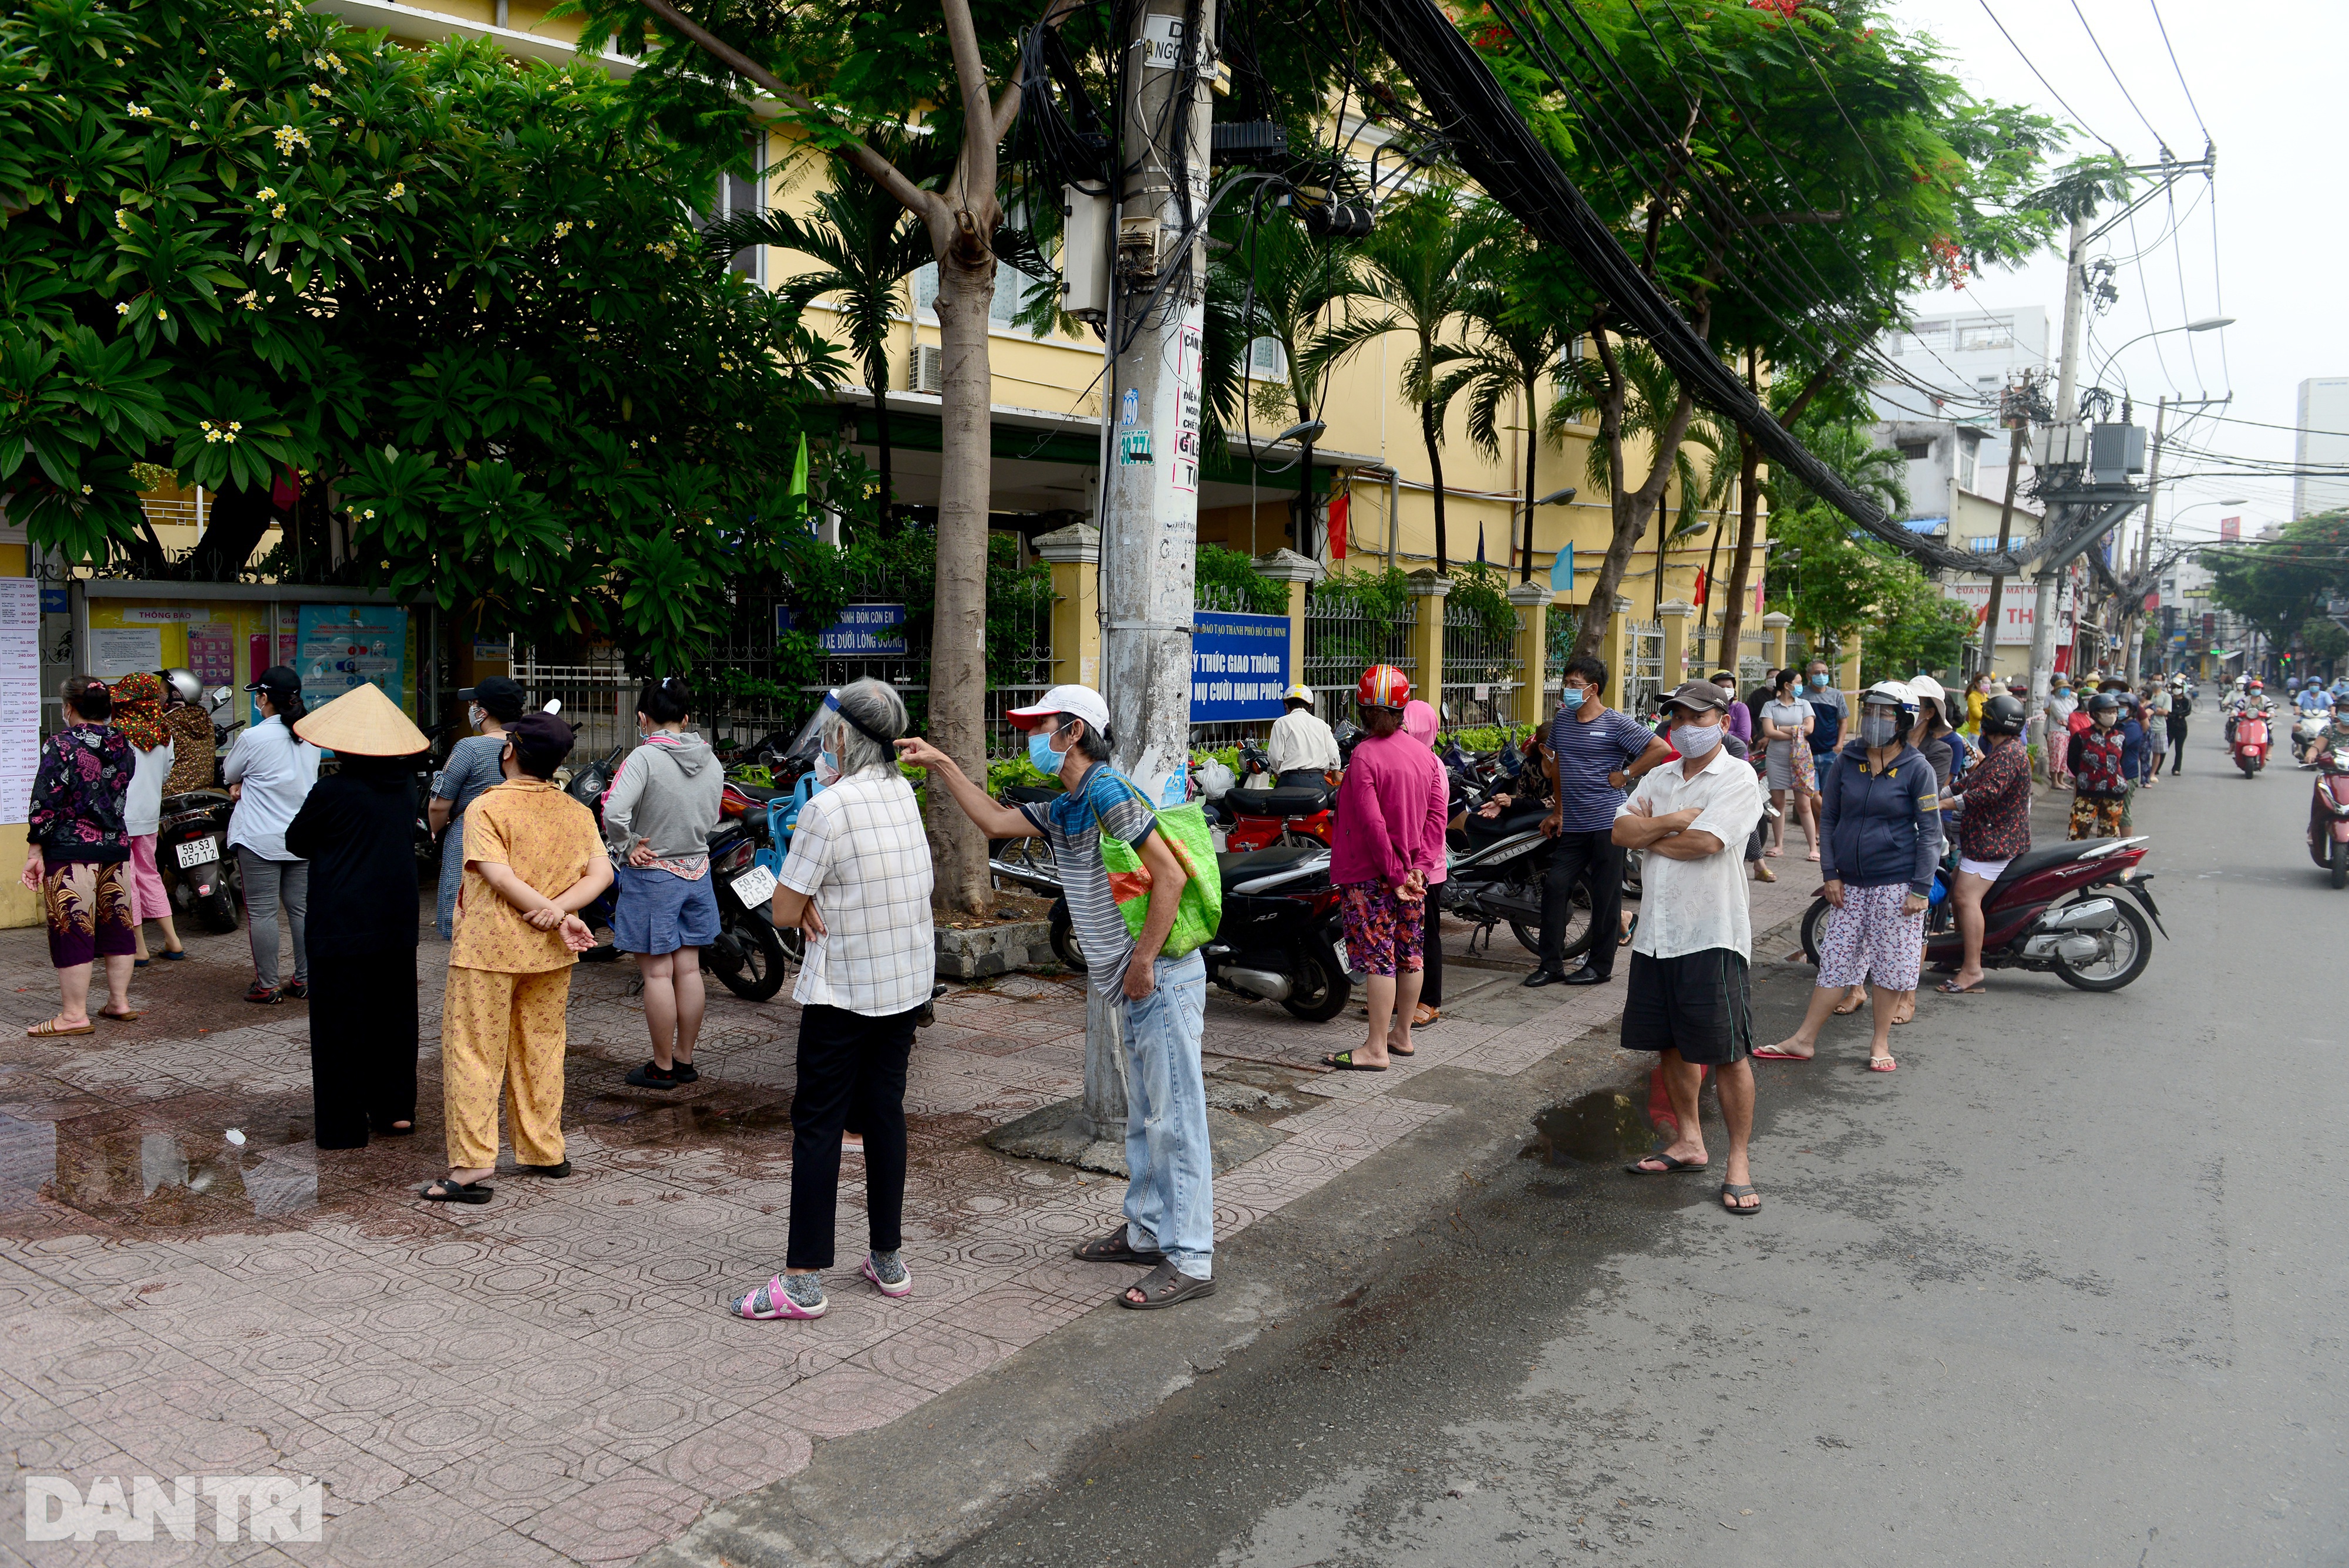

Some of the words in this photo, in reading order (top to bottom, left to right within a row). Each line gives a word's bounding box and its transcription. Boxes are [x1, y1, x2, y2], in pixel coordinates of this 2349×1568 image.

[139, 611, 171, 619] THÔNG
[840, 611, 854, 624] SINH
[870, 611, 883, 624] CON
[884, 611, 894, 623] EM
[1214, 624, 1225, 637] TẠO
[1226, 622, 1243, 635] THÀNH
[1244, 623, 1254, 636] PHỐ
[1255, 624, 1263, 637] HỒ
[1263, 625, 1273, 637] CHÍ
[1273, 627, 1286, 637] MINH
[826, 634, 835, 648] XE
[857, 630, 876, 649] LÒNG
[1200, 650, 1226, 673] THỨC
[1227, 655, 1249, 673] GIAO
[1250, 652, 1280, 674] THÔNG
[1194, 682, 1207, 705] NỤ
[1210, 679, 1232, 701] CƯỜI
[1234, 682, 1258, 705] HẠNH
[1260, 679, 1284, 700] PHÚC
[183, 839, 210, 854] 59-S3
[1492, 844, 1529, 863] SIRIUS
[181, 849, 216, 866] 057.12
[734, 866, 747, 875] HONDA
[737, 870, 766, 892] 59-S3
